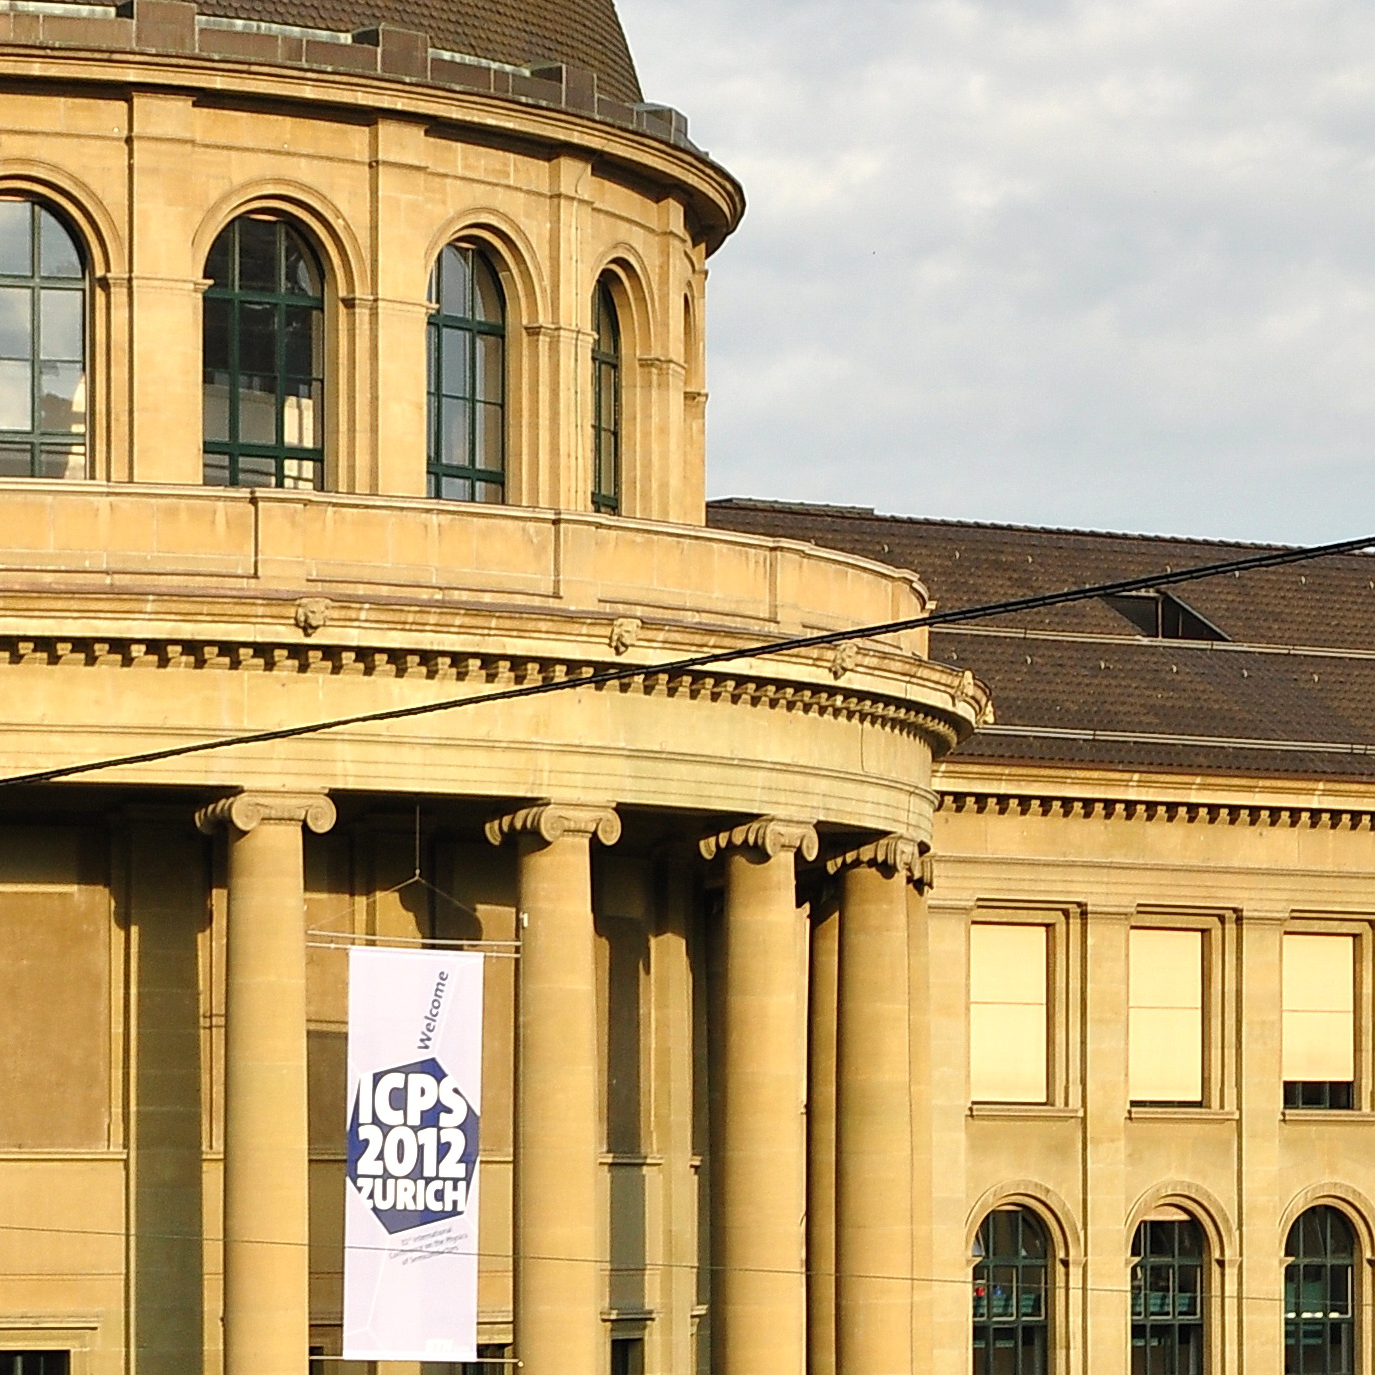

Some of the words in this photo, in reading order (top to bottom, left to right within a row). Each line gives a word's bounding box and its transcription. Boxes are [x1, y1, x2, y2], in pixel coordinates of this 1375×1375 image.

[417, 971, 449, 1049] Welcome
[358, 1072, 468, 1128] ICPS
[357, 1125, 467, 1178] 2012
[356, 1177, 467, 1212] ZURICH
